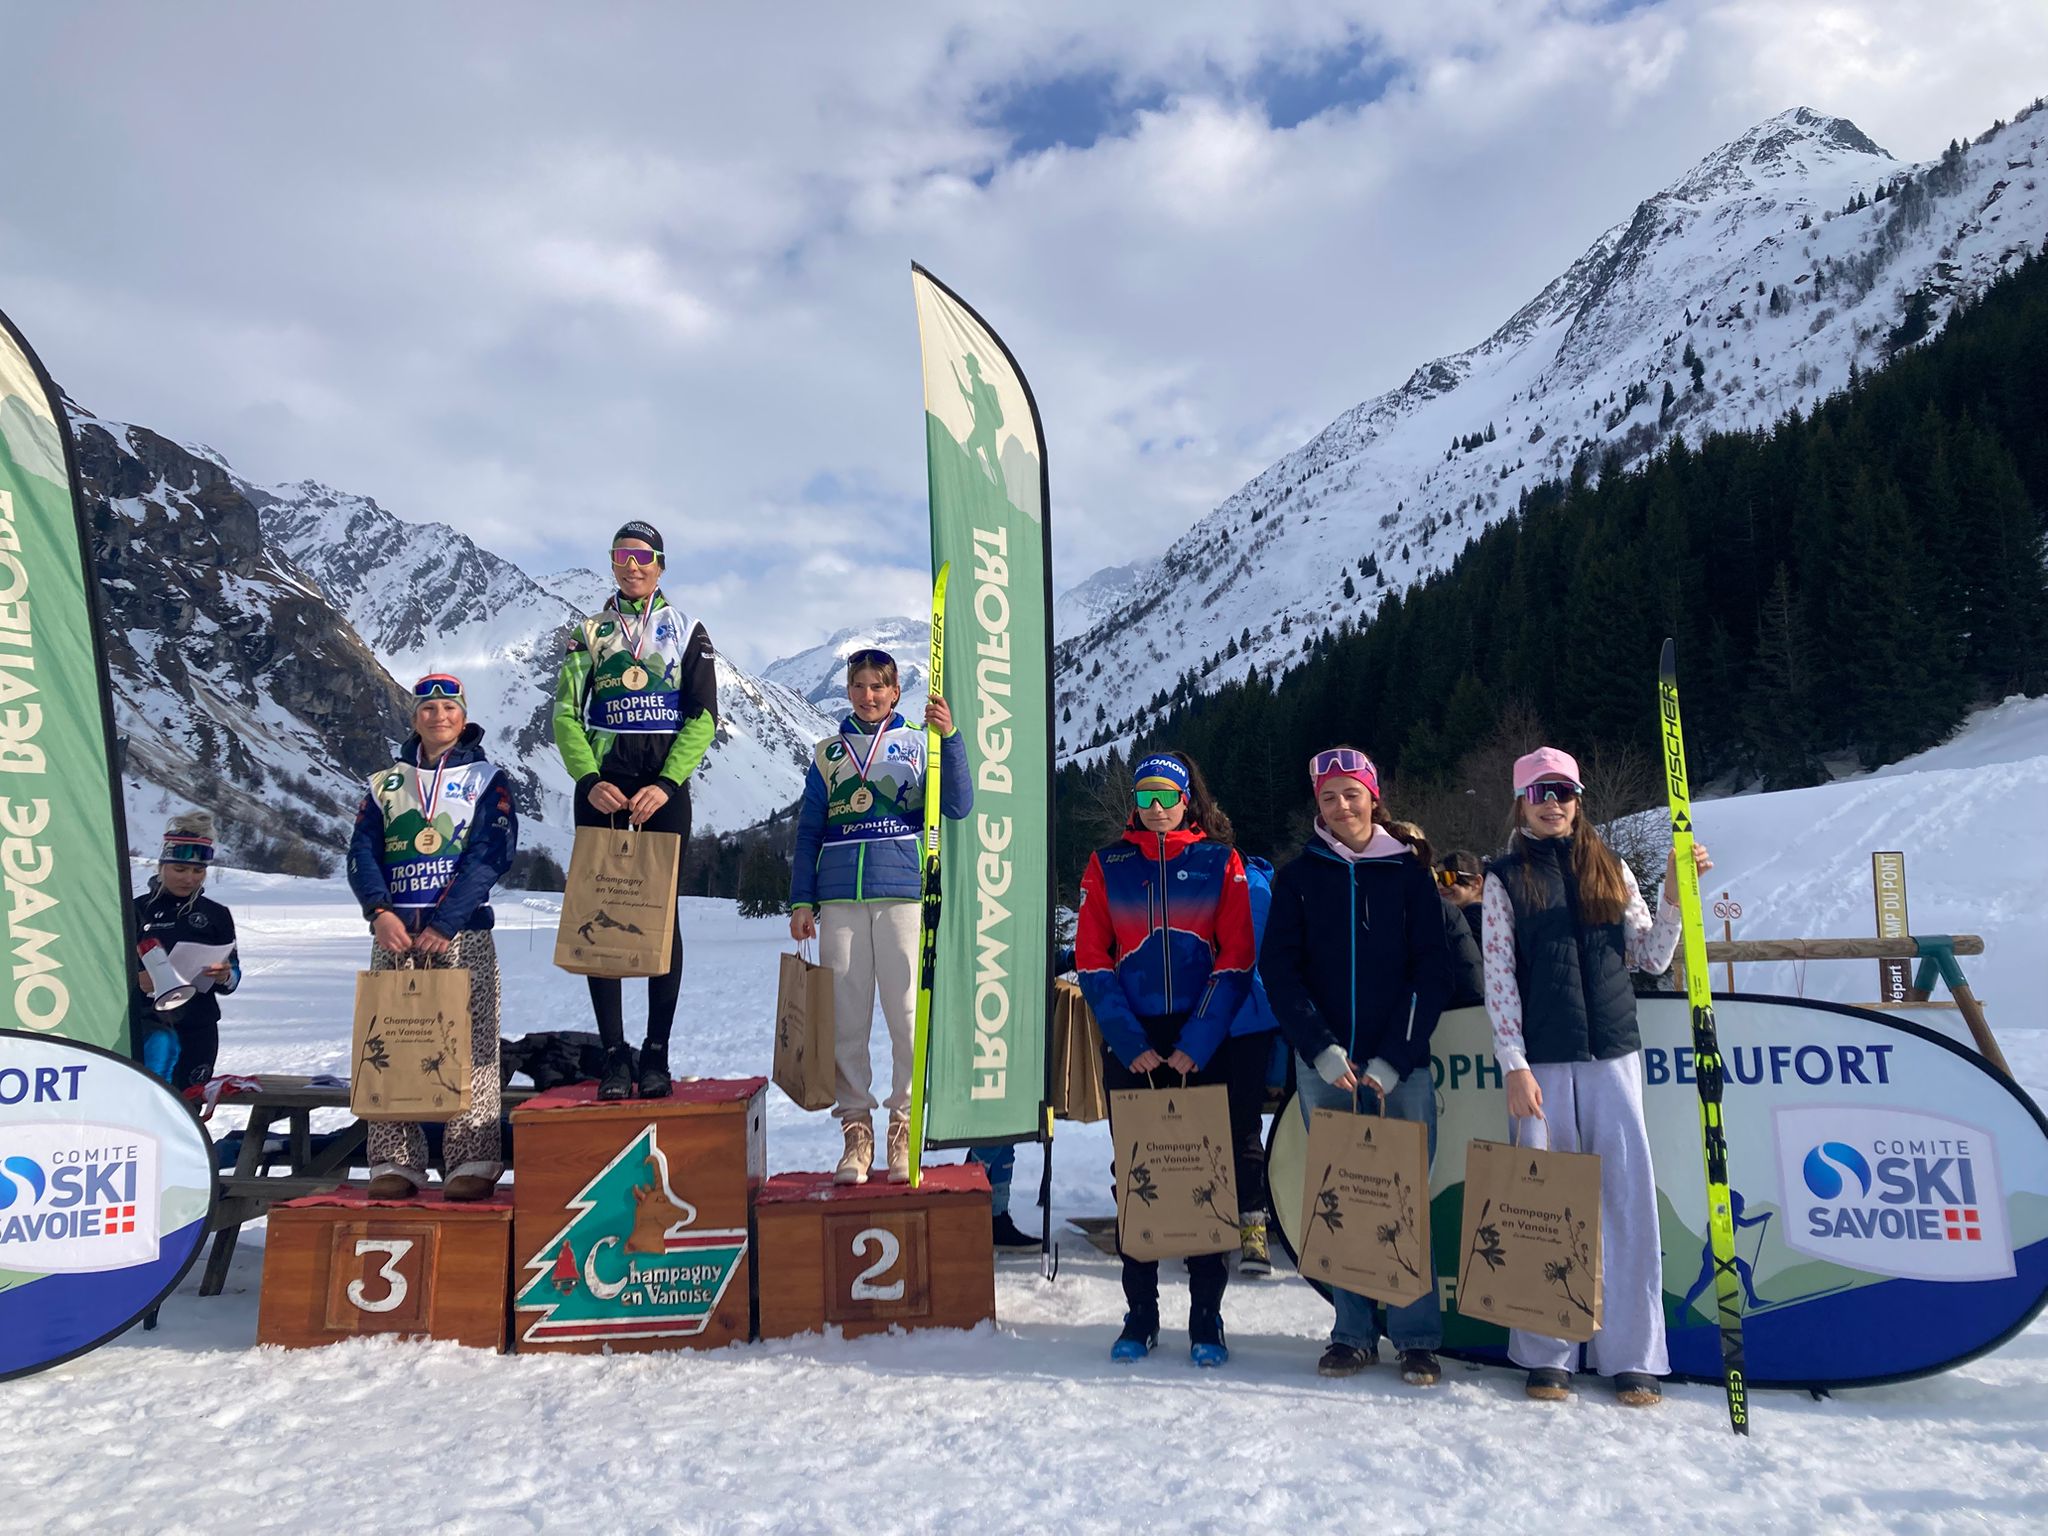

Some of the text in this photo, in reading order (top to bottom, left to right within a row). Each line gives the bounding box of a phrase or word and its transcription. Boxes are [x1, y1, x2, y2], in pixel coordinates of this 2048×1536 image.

[930, 612, 942, 702] ISCHER
[606, 693, 664, 712] TROPHÉE
[606, 713, 623, 725] DU
[832, 742, 842, 758] 2
[1663, 683, 1685, 801] FISCHER
[387, 775, 400, 789] 3
[422, 835, 434, 846] 3
[392, 858, 454, 879] TROPHÉE
[1881, 855, 1899, 889] PONT
[390, 880, 407, 894] DU
[595, 874, 643, 886] Champagny
[1884, 892, 1900, 910] DU
[1889, 964, 1906, 1003] épart
[384, 1016, 435, 1026] Champagny
[399, 1028, 432, 1036] Vanoise
[52, 1145, 138, 1164] COMITE
[1146, 1142, 1201, 1152] Champagny
[1874, 1140, 1970, 1156] COMITE
[1164, 1155, 1200, 1164] Vanoise
[49, 1161, 137, 1208] SKI
[1339, 1168, 1391, 1188] Champagny
[1877, 1158, 1977, 1205] SKI
[1499, 1203, 1562, 1223] Champagny
[0, 1208, 101, 1244] AVOIE
[1518, 1220, 1559, 1235] Vanoise
[1809, 1207, 1943, 1240] SAVOIE
[584, 1236, 722, 1299] Champagny
[851, 1228, 905, 1301] 2
[347, 1240, 413, 1312] 3
[621, 1284, 712, 1305] en Vanoise
